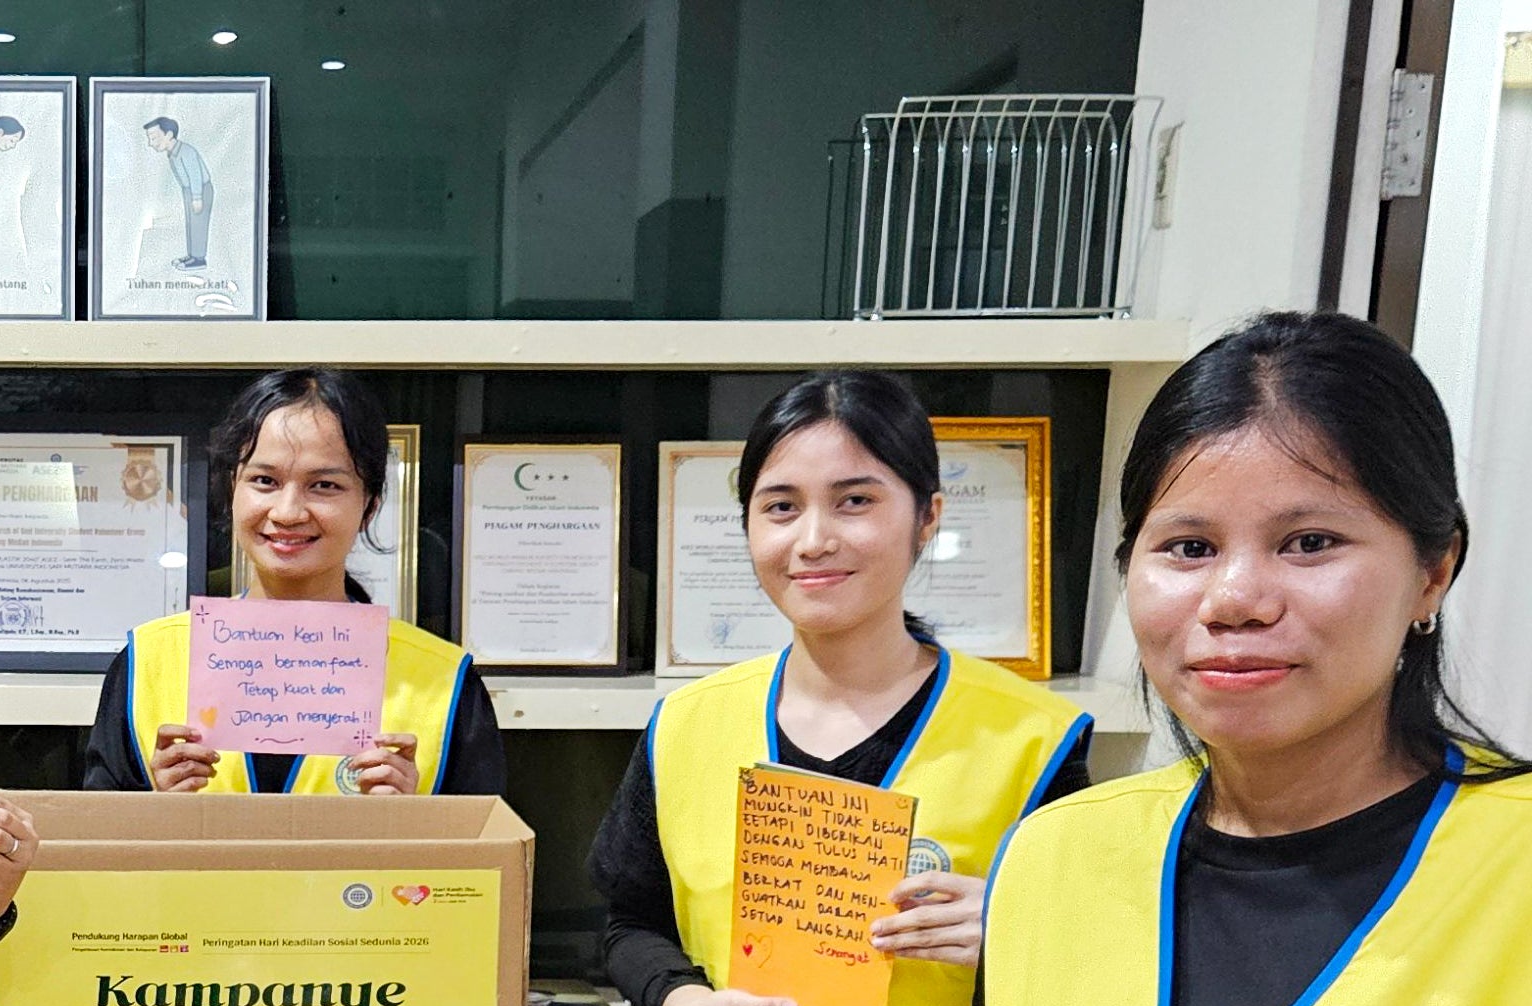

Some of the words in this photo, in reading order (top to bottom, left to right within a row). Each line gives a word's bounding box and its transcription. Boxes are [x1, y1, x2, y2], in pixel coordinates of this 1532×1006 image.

[126, 278, 162, 290] Tuhan
[484, 522, 523, 530] PIAGAM
[527, 522, 601, 530] PENGHARGAAN
[213, 619, 284, 644] Bantuan
[207, 653, 263, 676] Semoga
[237, 681, 278, 701] Tetap
[321, 680, 346, 696] dan
[746, 779, 834, 806] BANTUAN
[744, 798, 812, 817] MUNGKIN
[822, 809, 863, 828] TIDAK
[806, 823, 883, 850] DIBERIKAN
[740, 850, 795, 869] SEMOGA
[743, 829, 804, 850] DENGAN
[813, 841, 857, 860] TULUS
[868, 851, 903, 871] HATI
[743, 871, 802, 891] BERKAT
[816, 884, 844, 901] DAN
[741, 889, 806, 910] GUATKAN
[72, 932, 120, 942] Pendukung
[122, 932, 159, 942] Harapan
[160, 932, 188, 940] Global
[202, 937, 255, 949] Peringatan
[258, 937, 279, 947] Hari
[282, 937, 325, 947] Keadilan
[327, 937, 357, 947] Sosial
[360, 937, 401, 947] Sedunia
[403, 937, 430, 947] 2026
